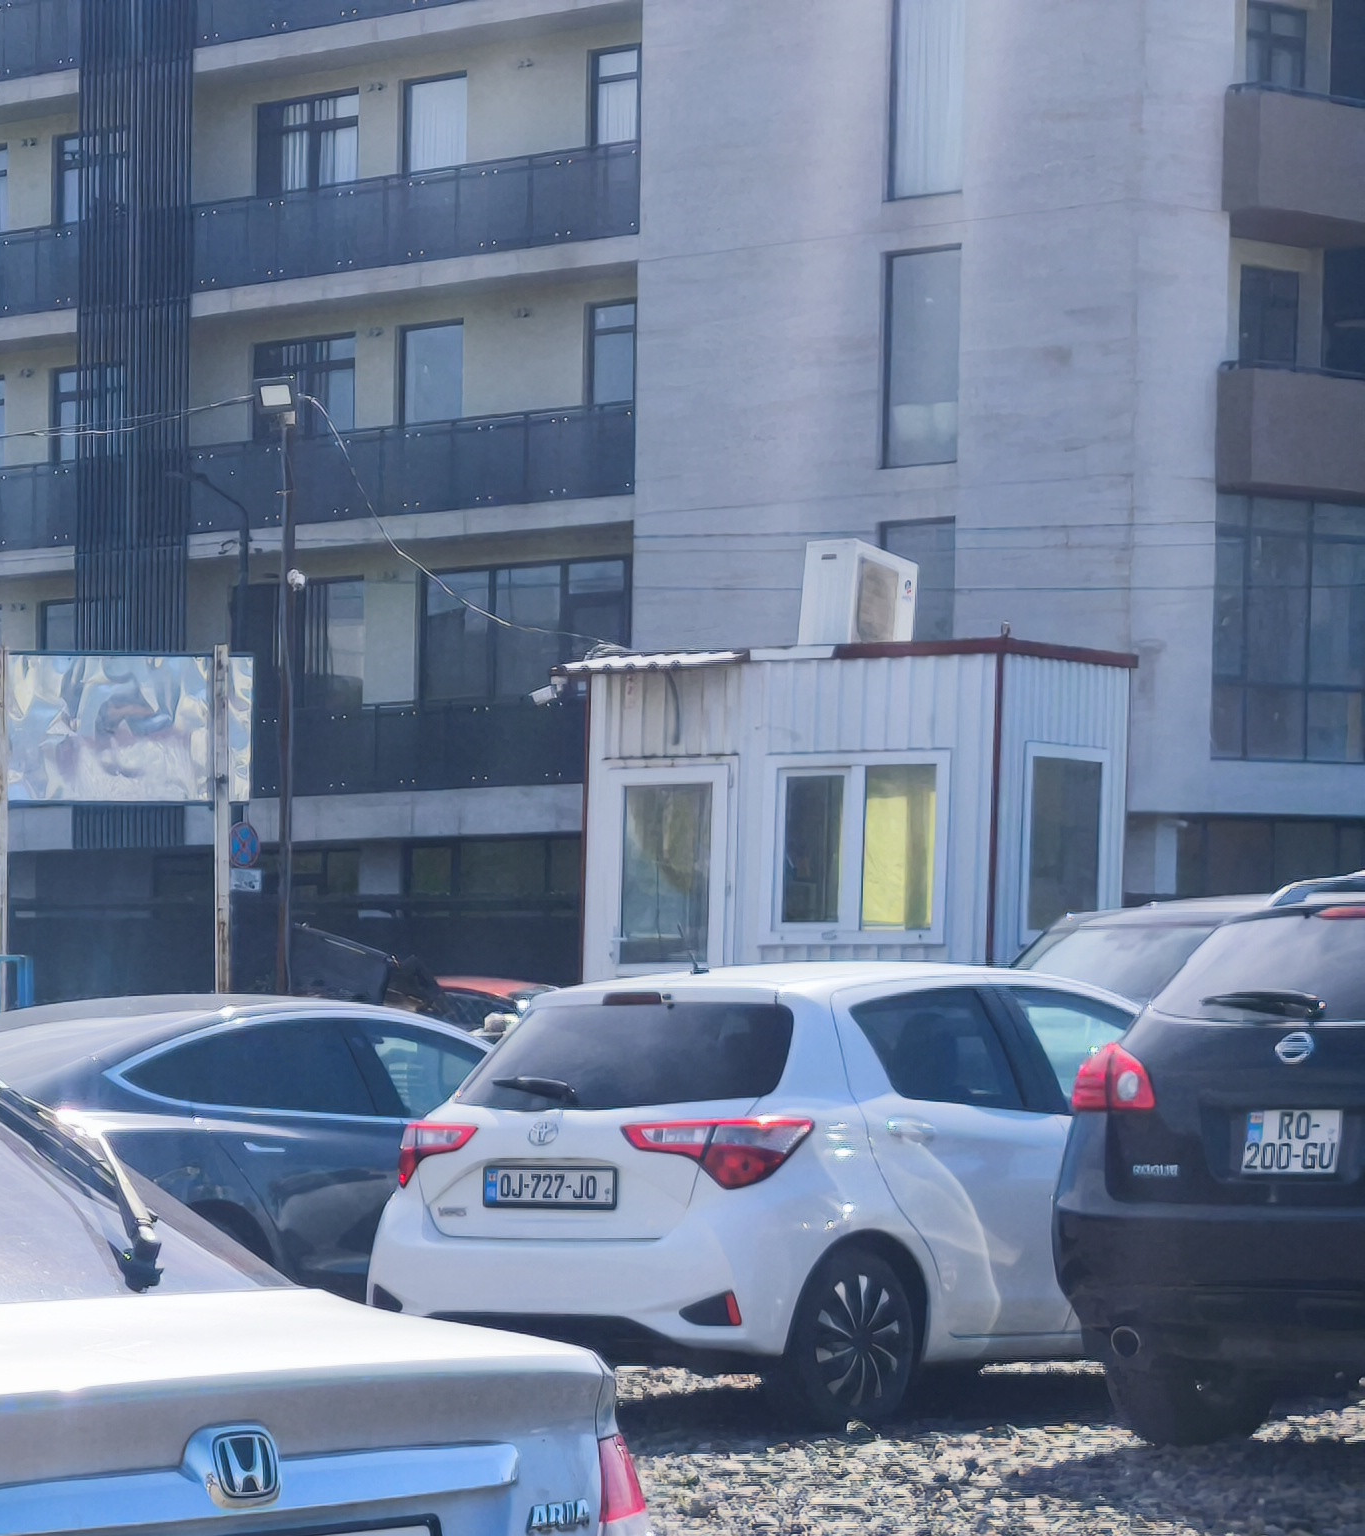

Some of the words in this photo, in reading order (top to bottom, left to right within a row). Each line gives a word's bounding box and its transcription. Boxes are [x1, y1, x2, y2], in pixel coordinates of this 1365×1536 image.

[1244, 1142, 1336, 1170] 200-GU
[499, 1172, 598, 1200] OJ-727-JO
[528, 1498, 590, 1532] ARIA
